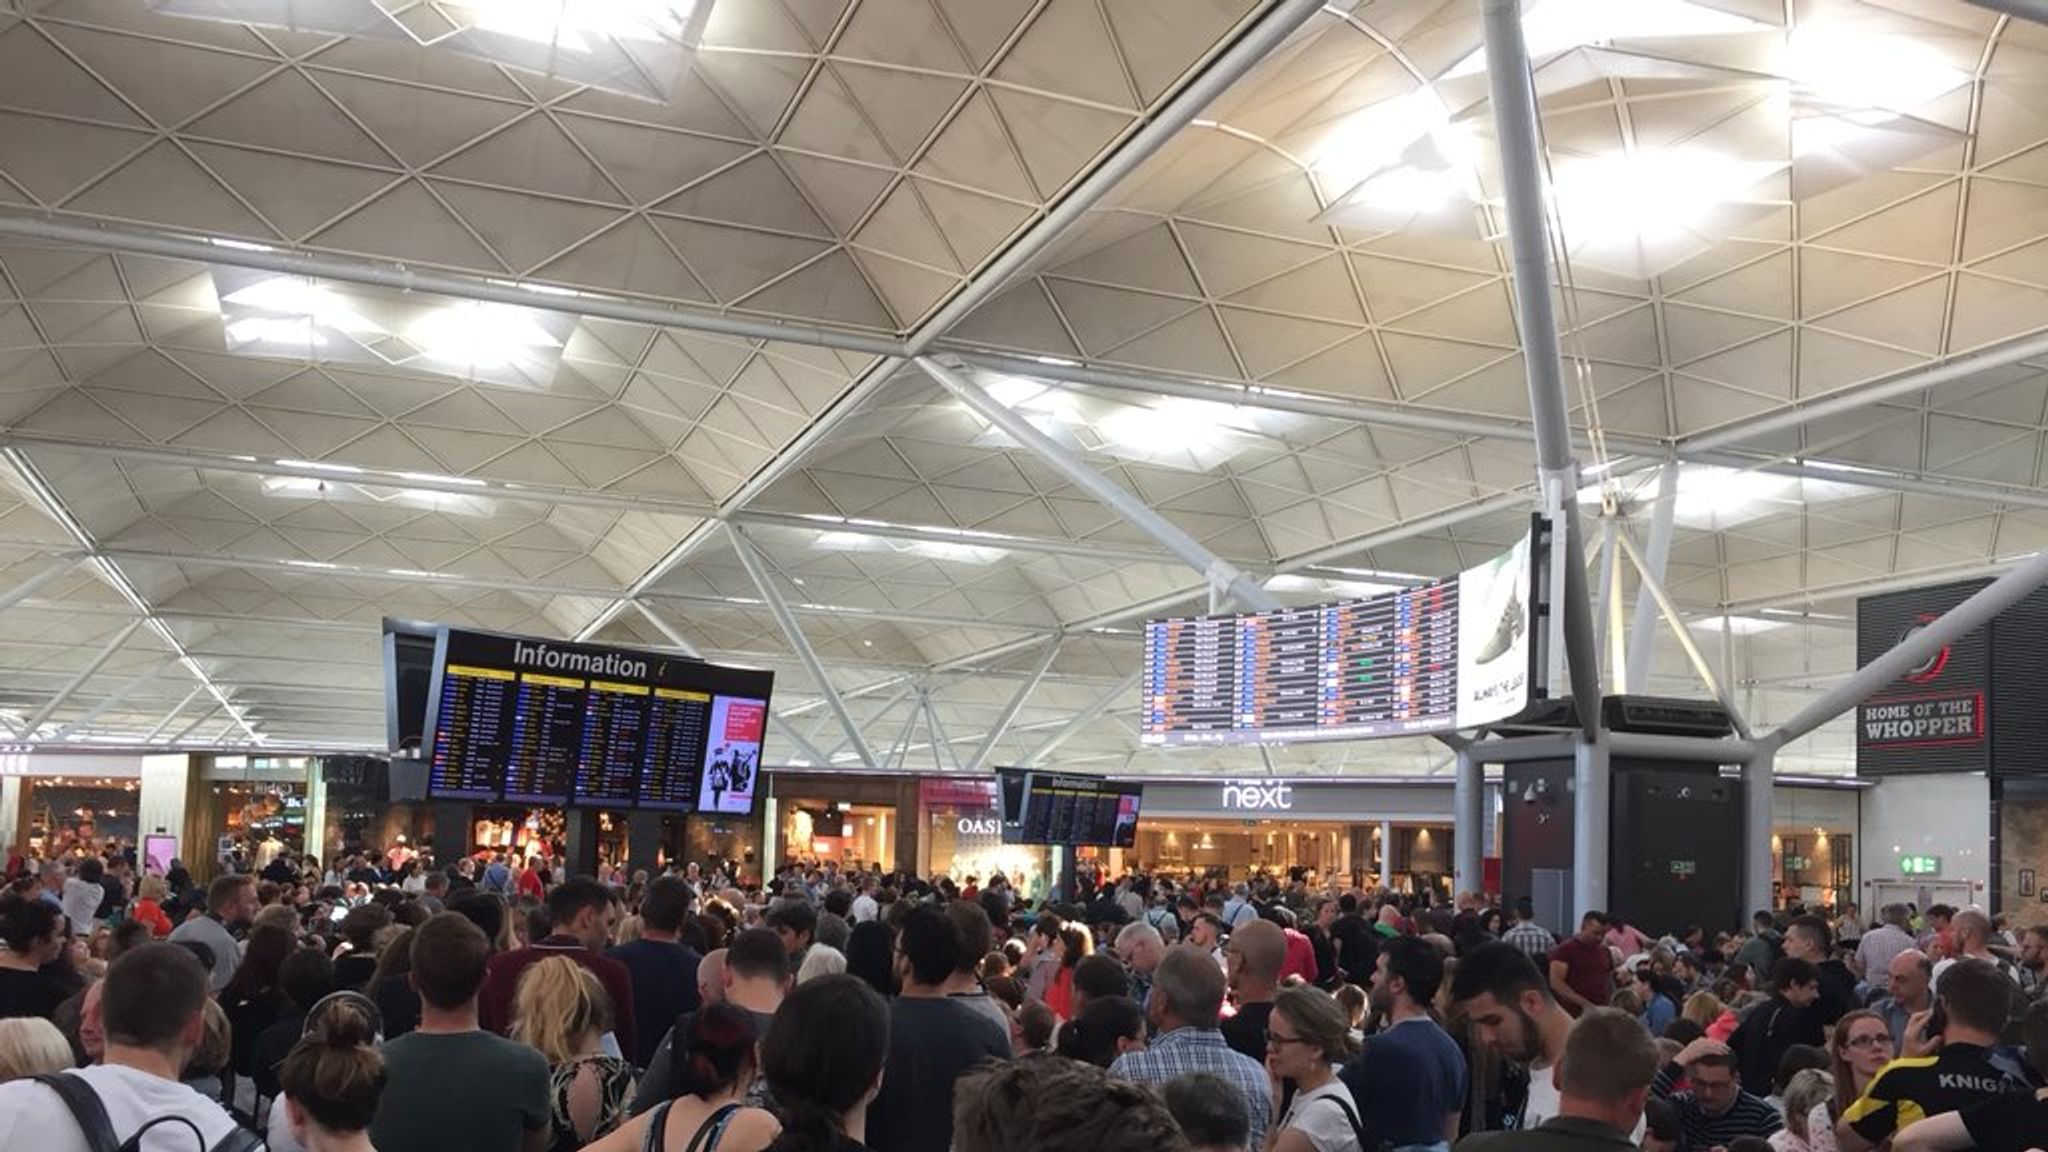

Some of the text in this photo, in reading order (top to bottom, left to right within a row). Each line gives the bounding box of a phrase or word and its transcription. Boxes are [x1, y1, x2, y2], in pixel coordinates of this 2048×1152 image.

[513, 641, 647, 678] Information
[1865, 699, 1972, 720] HOME OF THE
[1865, 716, 1972, 739] WHOPPER
[1222, 786, 1292, 809] next
[957, 818, 1002, 835] OASI
[1938, 1073, 2001, 1092] KNIG
